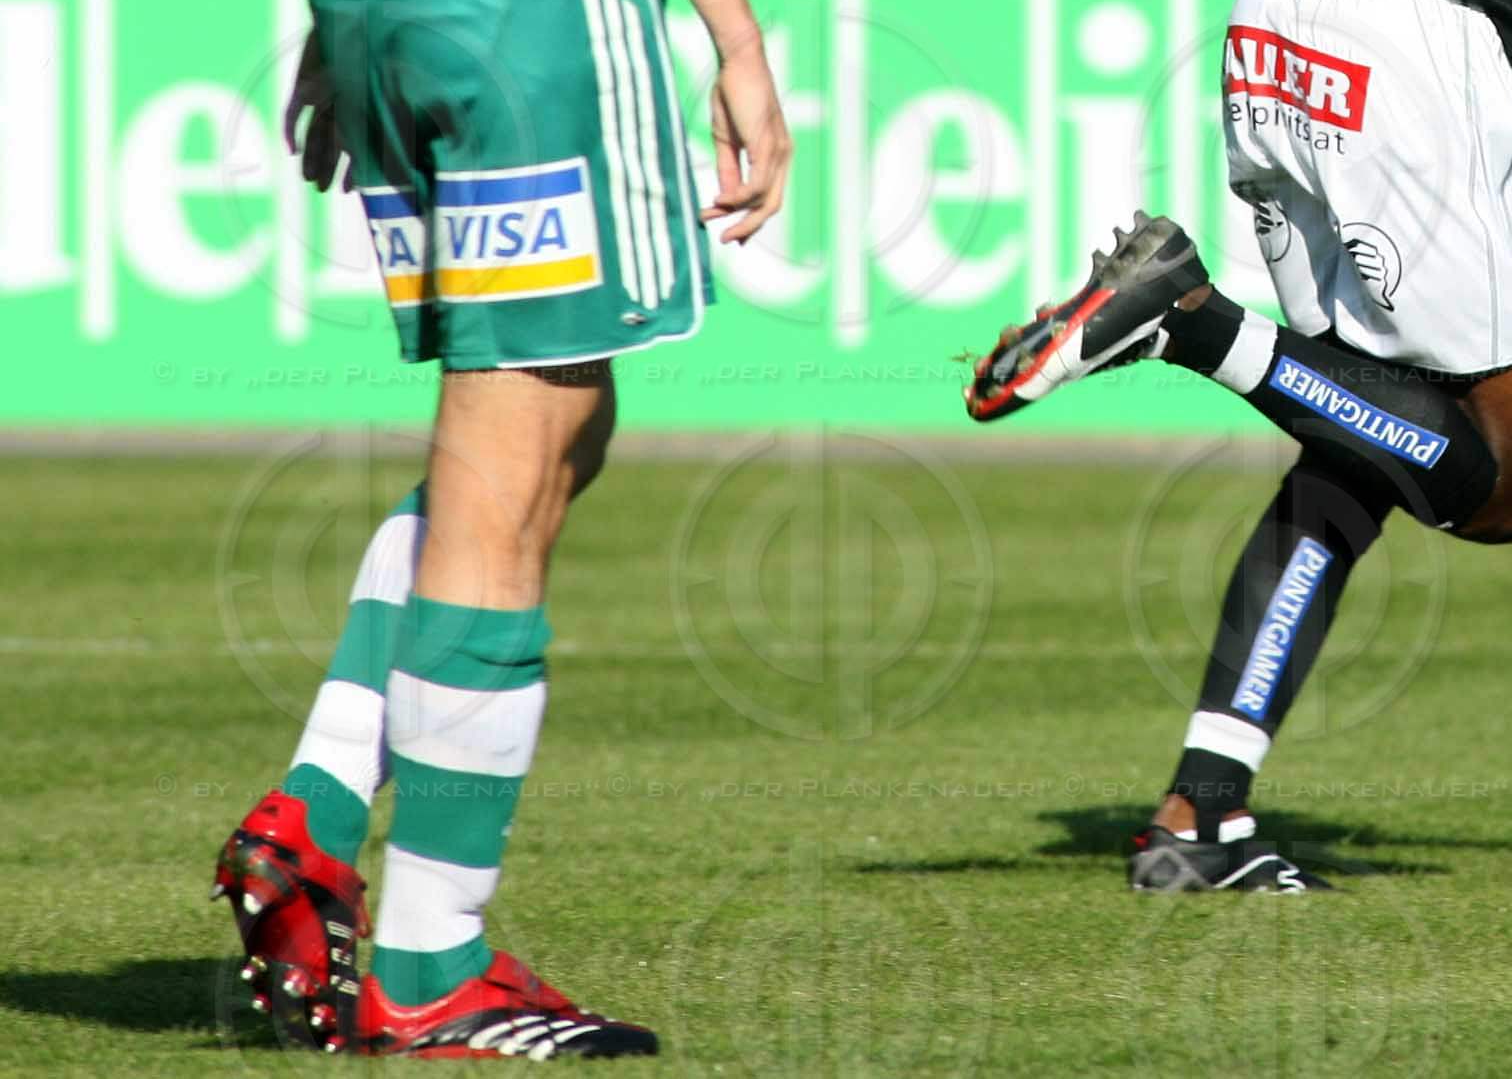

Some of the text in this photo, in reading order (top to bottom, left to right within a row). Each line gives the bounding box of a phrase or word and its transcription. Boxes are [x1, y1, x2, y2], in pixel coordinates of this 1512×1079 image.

[1224, 37, 1351, 119] AUER
[443, 207, 568, 260] VISA
[1276, 361, 1440, 463] PUNTIGAMER
[1238, 546, 1327, 714] PUNTIGAMER
